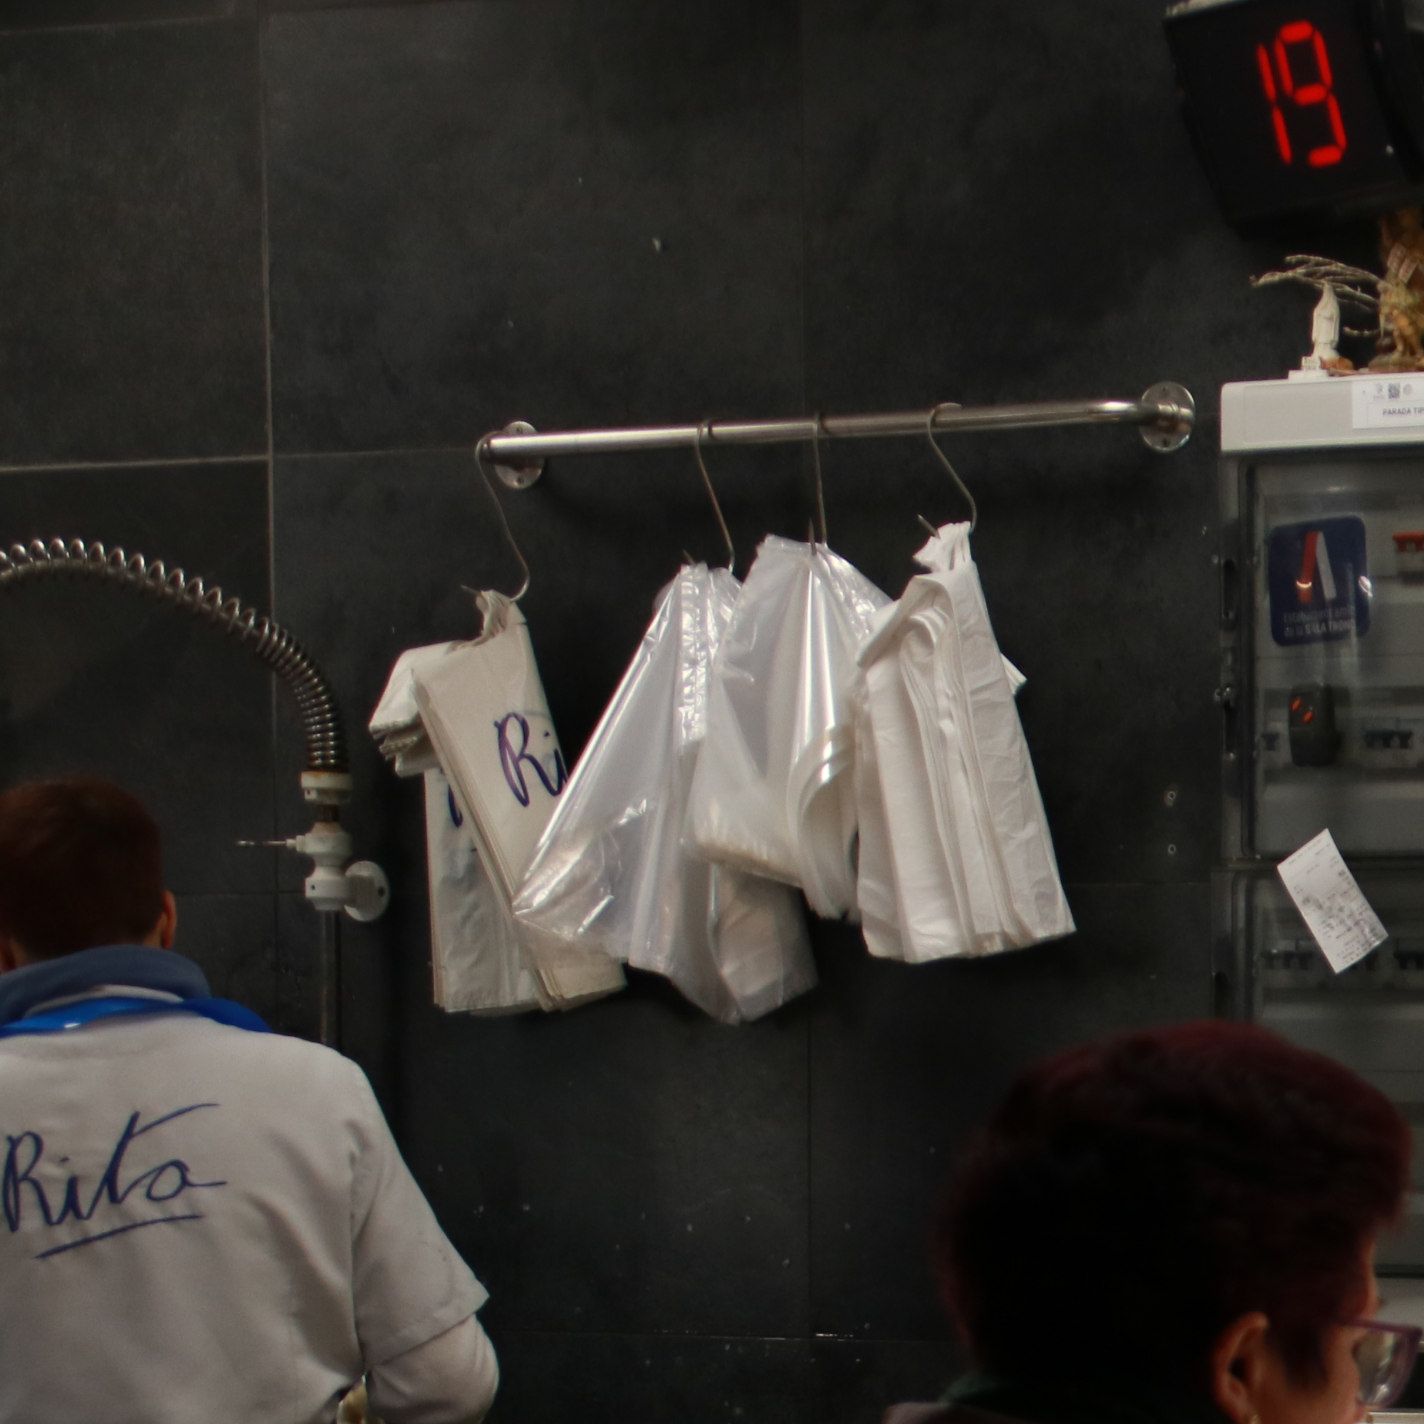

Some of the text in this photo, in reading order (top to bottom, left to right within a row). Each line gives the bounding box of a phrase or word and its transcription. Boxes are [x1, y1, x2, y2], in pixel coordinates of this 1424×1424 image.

[1256, 20, 1347, 167] 19
[494, 712, 568, 807] Ri
[2, 1103, 228, 1233] Rita
